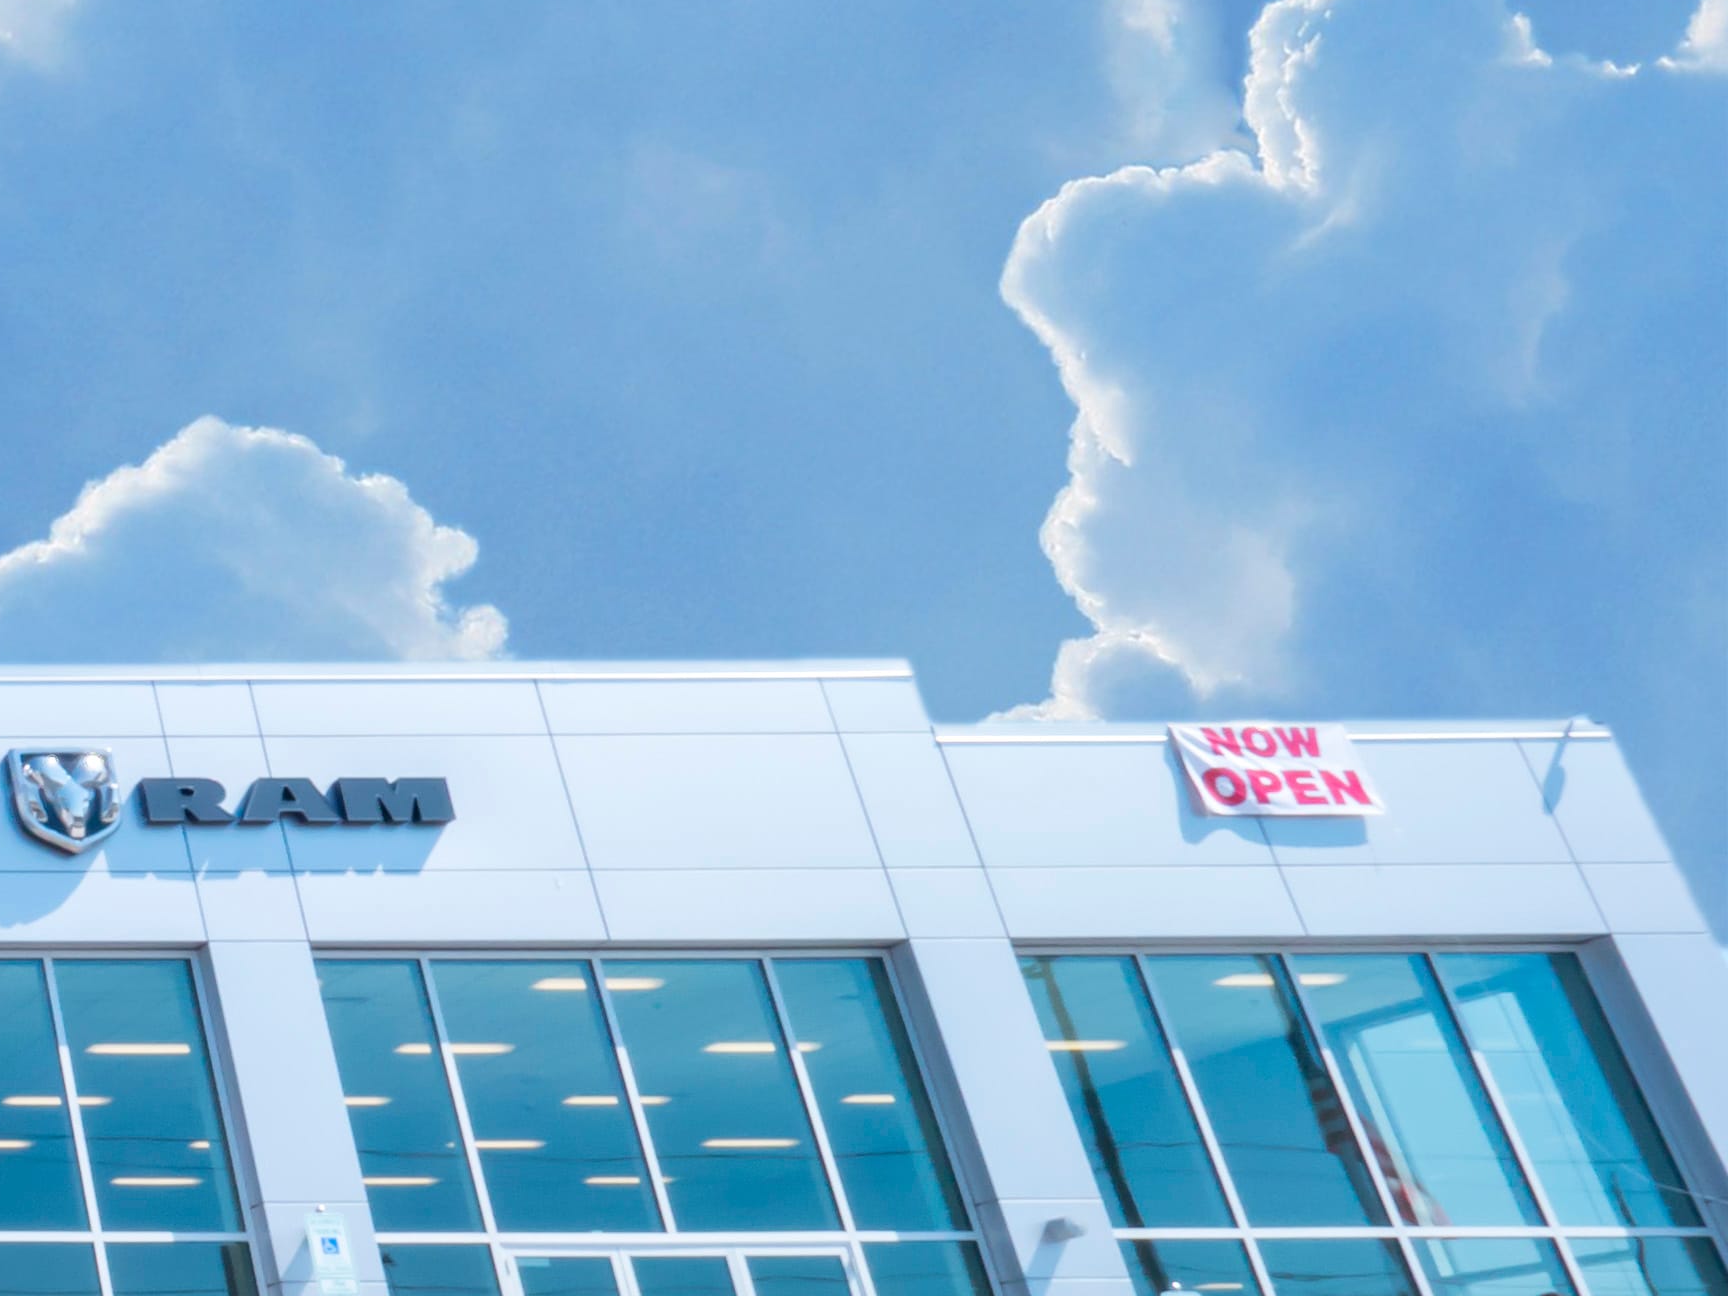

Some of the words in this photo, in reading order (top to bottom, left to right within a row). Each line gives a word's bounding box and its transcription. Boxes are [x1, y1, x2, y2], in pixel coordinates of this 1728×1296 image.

[1200, 727, 1321, 758] NOW
[135, 777, 456, 826] RAM
[1202, 767, 1373, 807] OPEN
